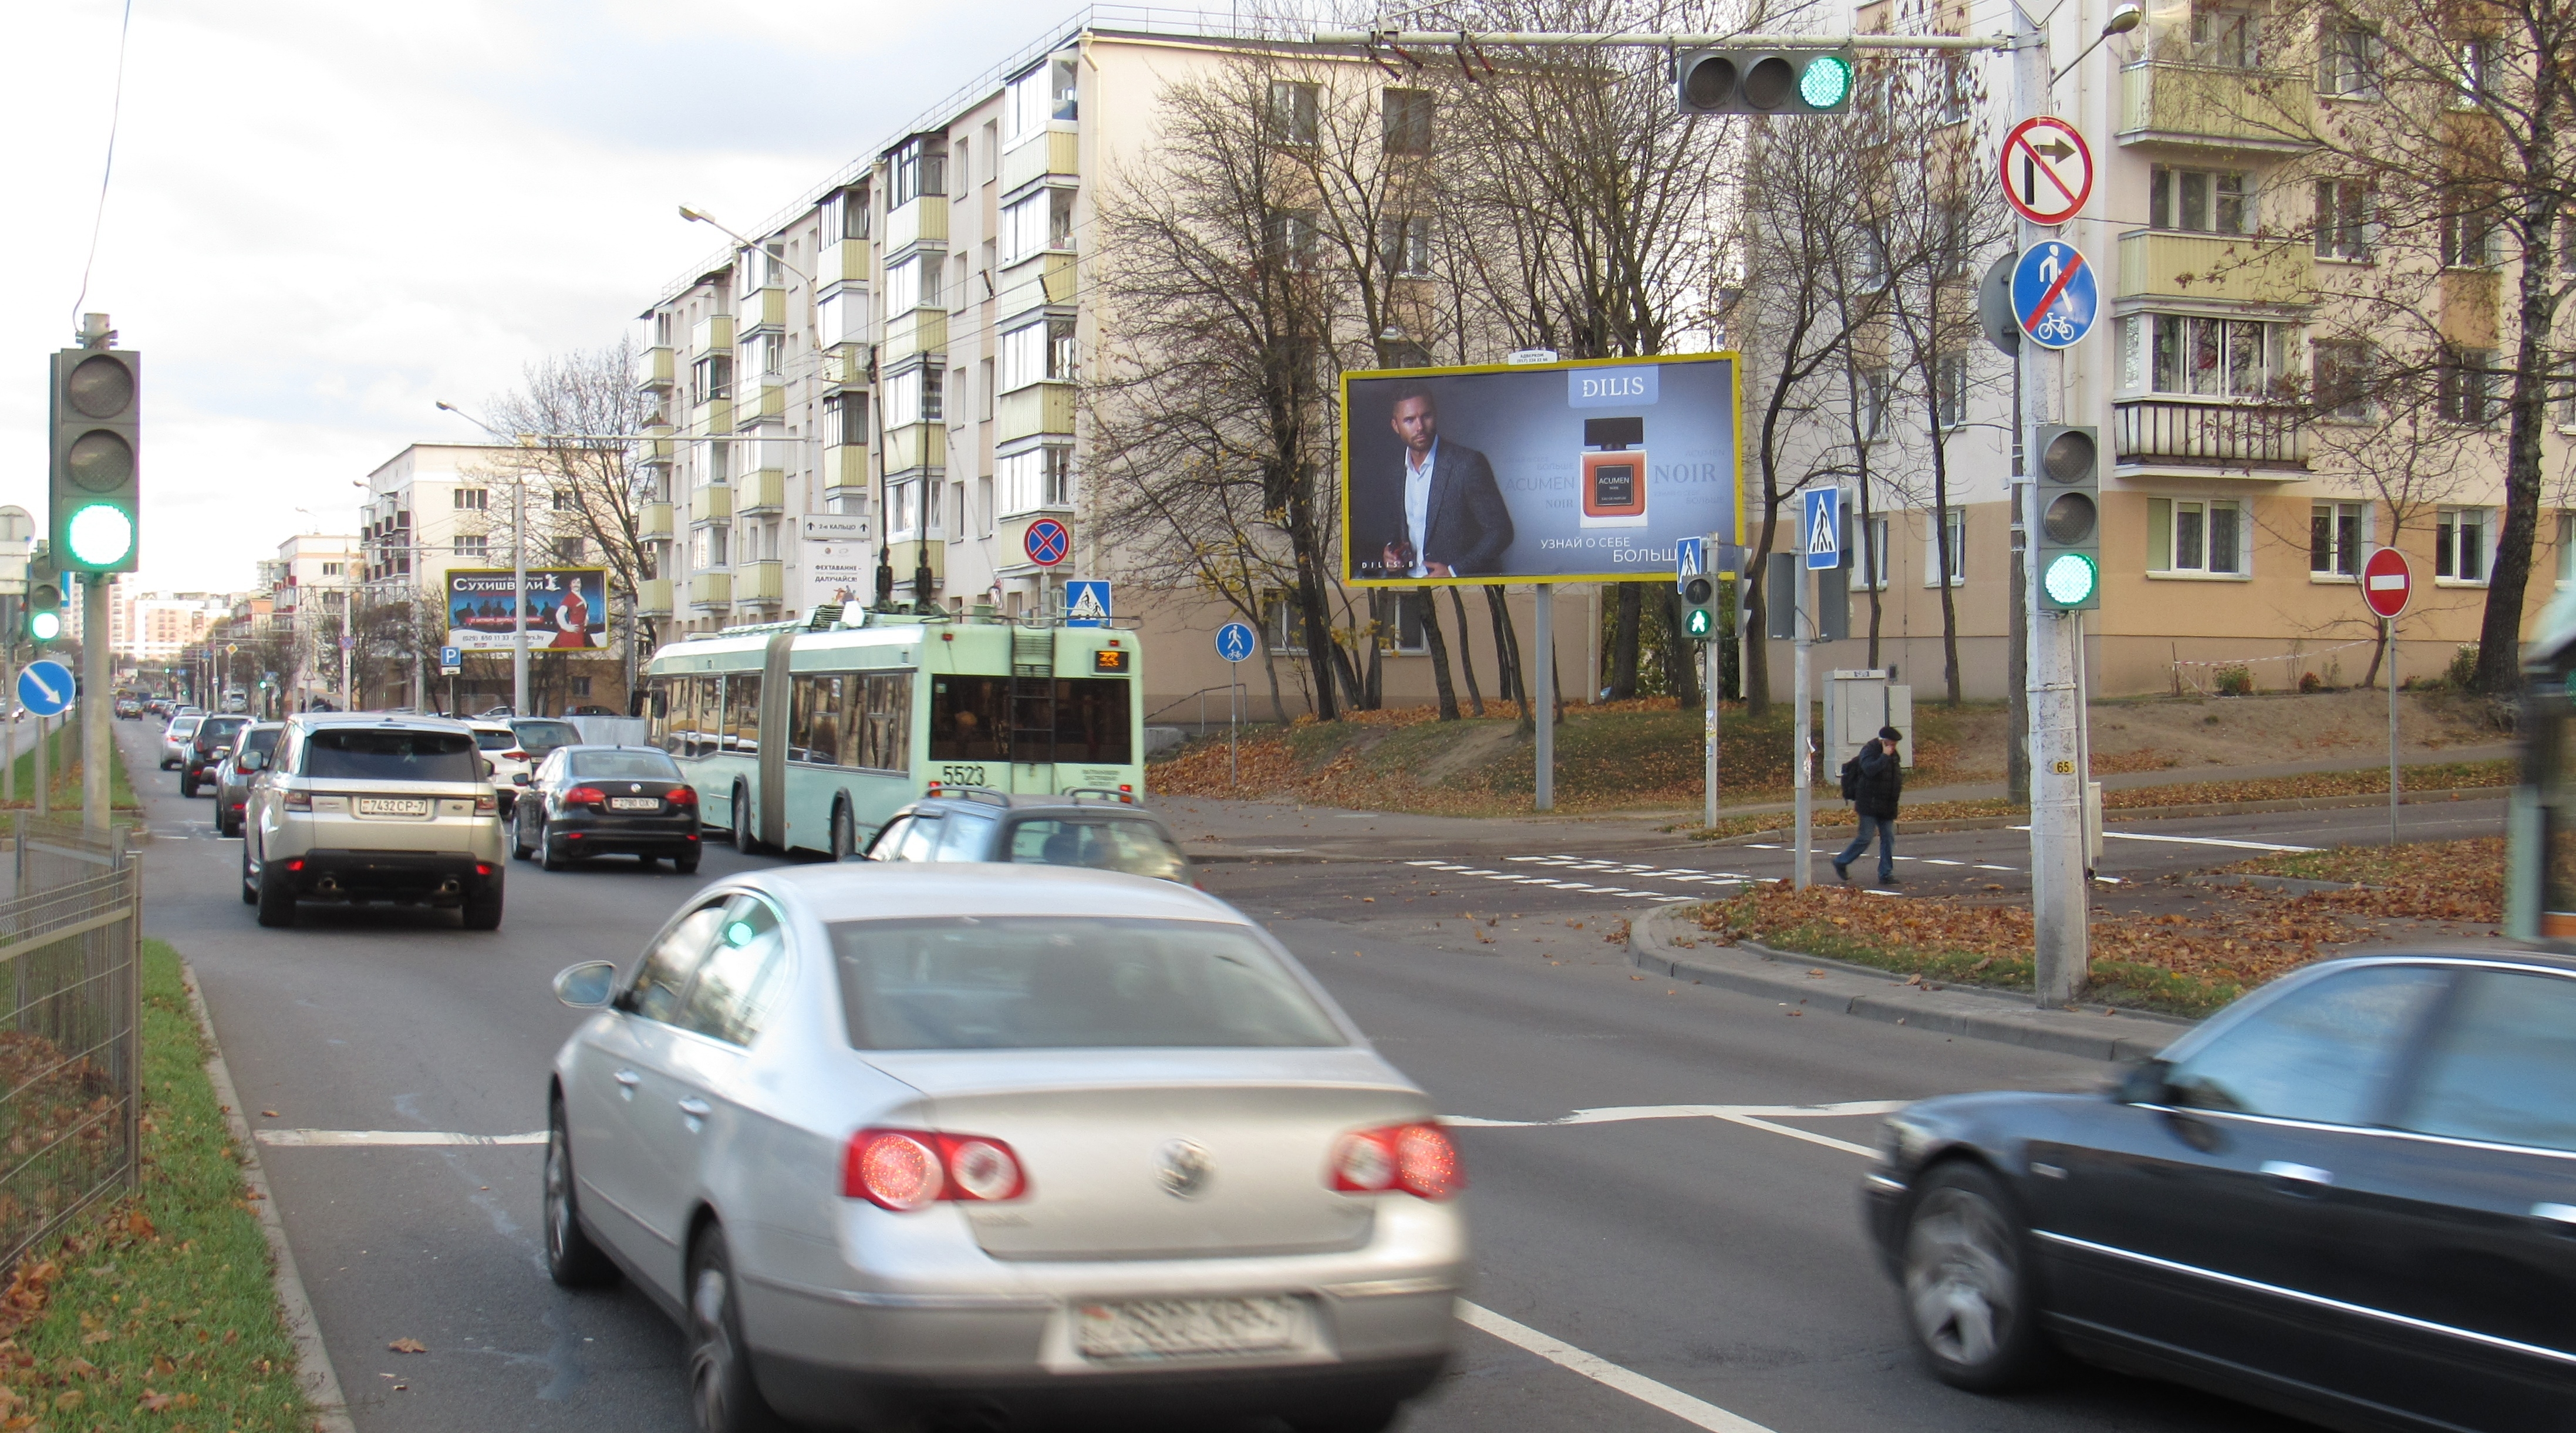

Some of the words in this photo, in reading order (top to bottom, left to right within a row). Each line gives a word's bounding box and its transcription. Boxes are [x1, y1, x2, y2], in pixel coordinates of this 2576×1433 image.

[1583, 377, 1644, 397] DILIS
[1654, 463, 1717, 484] NOIR
[1504, 477, 1574, 491] ACUMEN
[1546, 499, 1573, 508] NOIR
[1540, 537, 1582, 549] УЗНАЙ
[1586, 538, 1596, 548] О
[1599, 537, 1630, 547] СЕБЕ
[1613, 548, 1677, 563] БОЛЬШ
[453, 578, 544, 591] СУХИШВЛИ
[447, 649, 457, 663] P
[2057, 761, 2069, 773] 65
[943, 766, 986, 786] 5523
